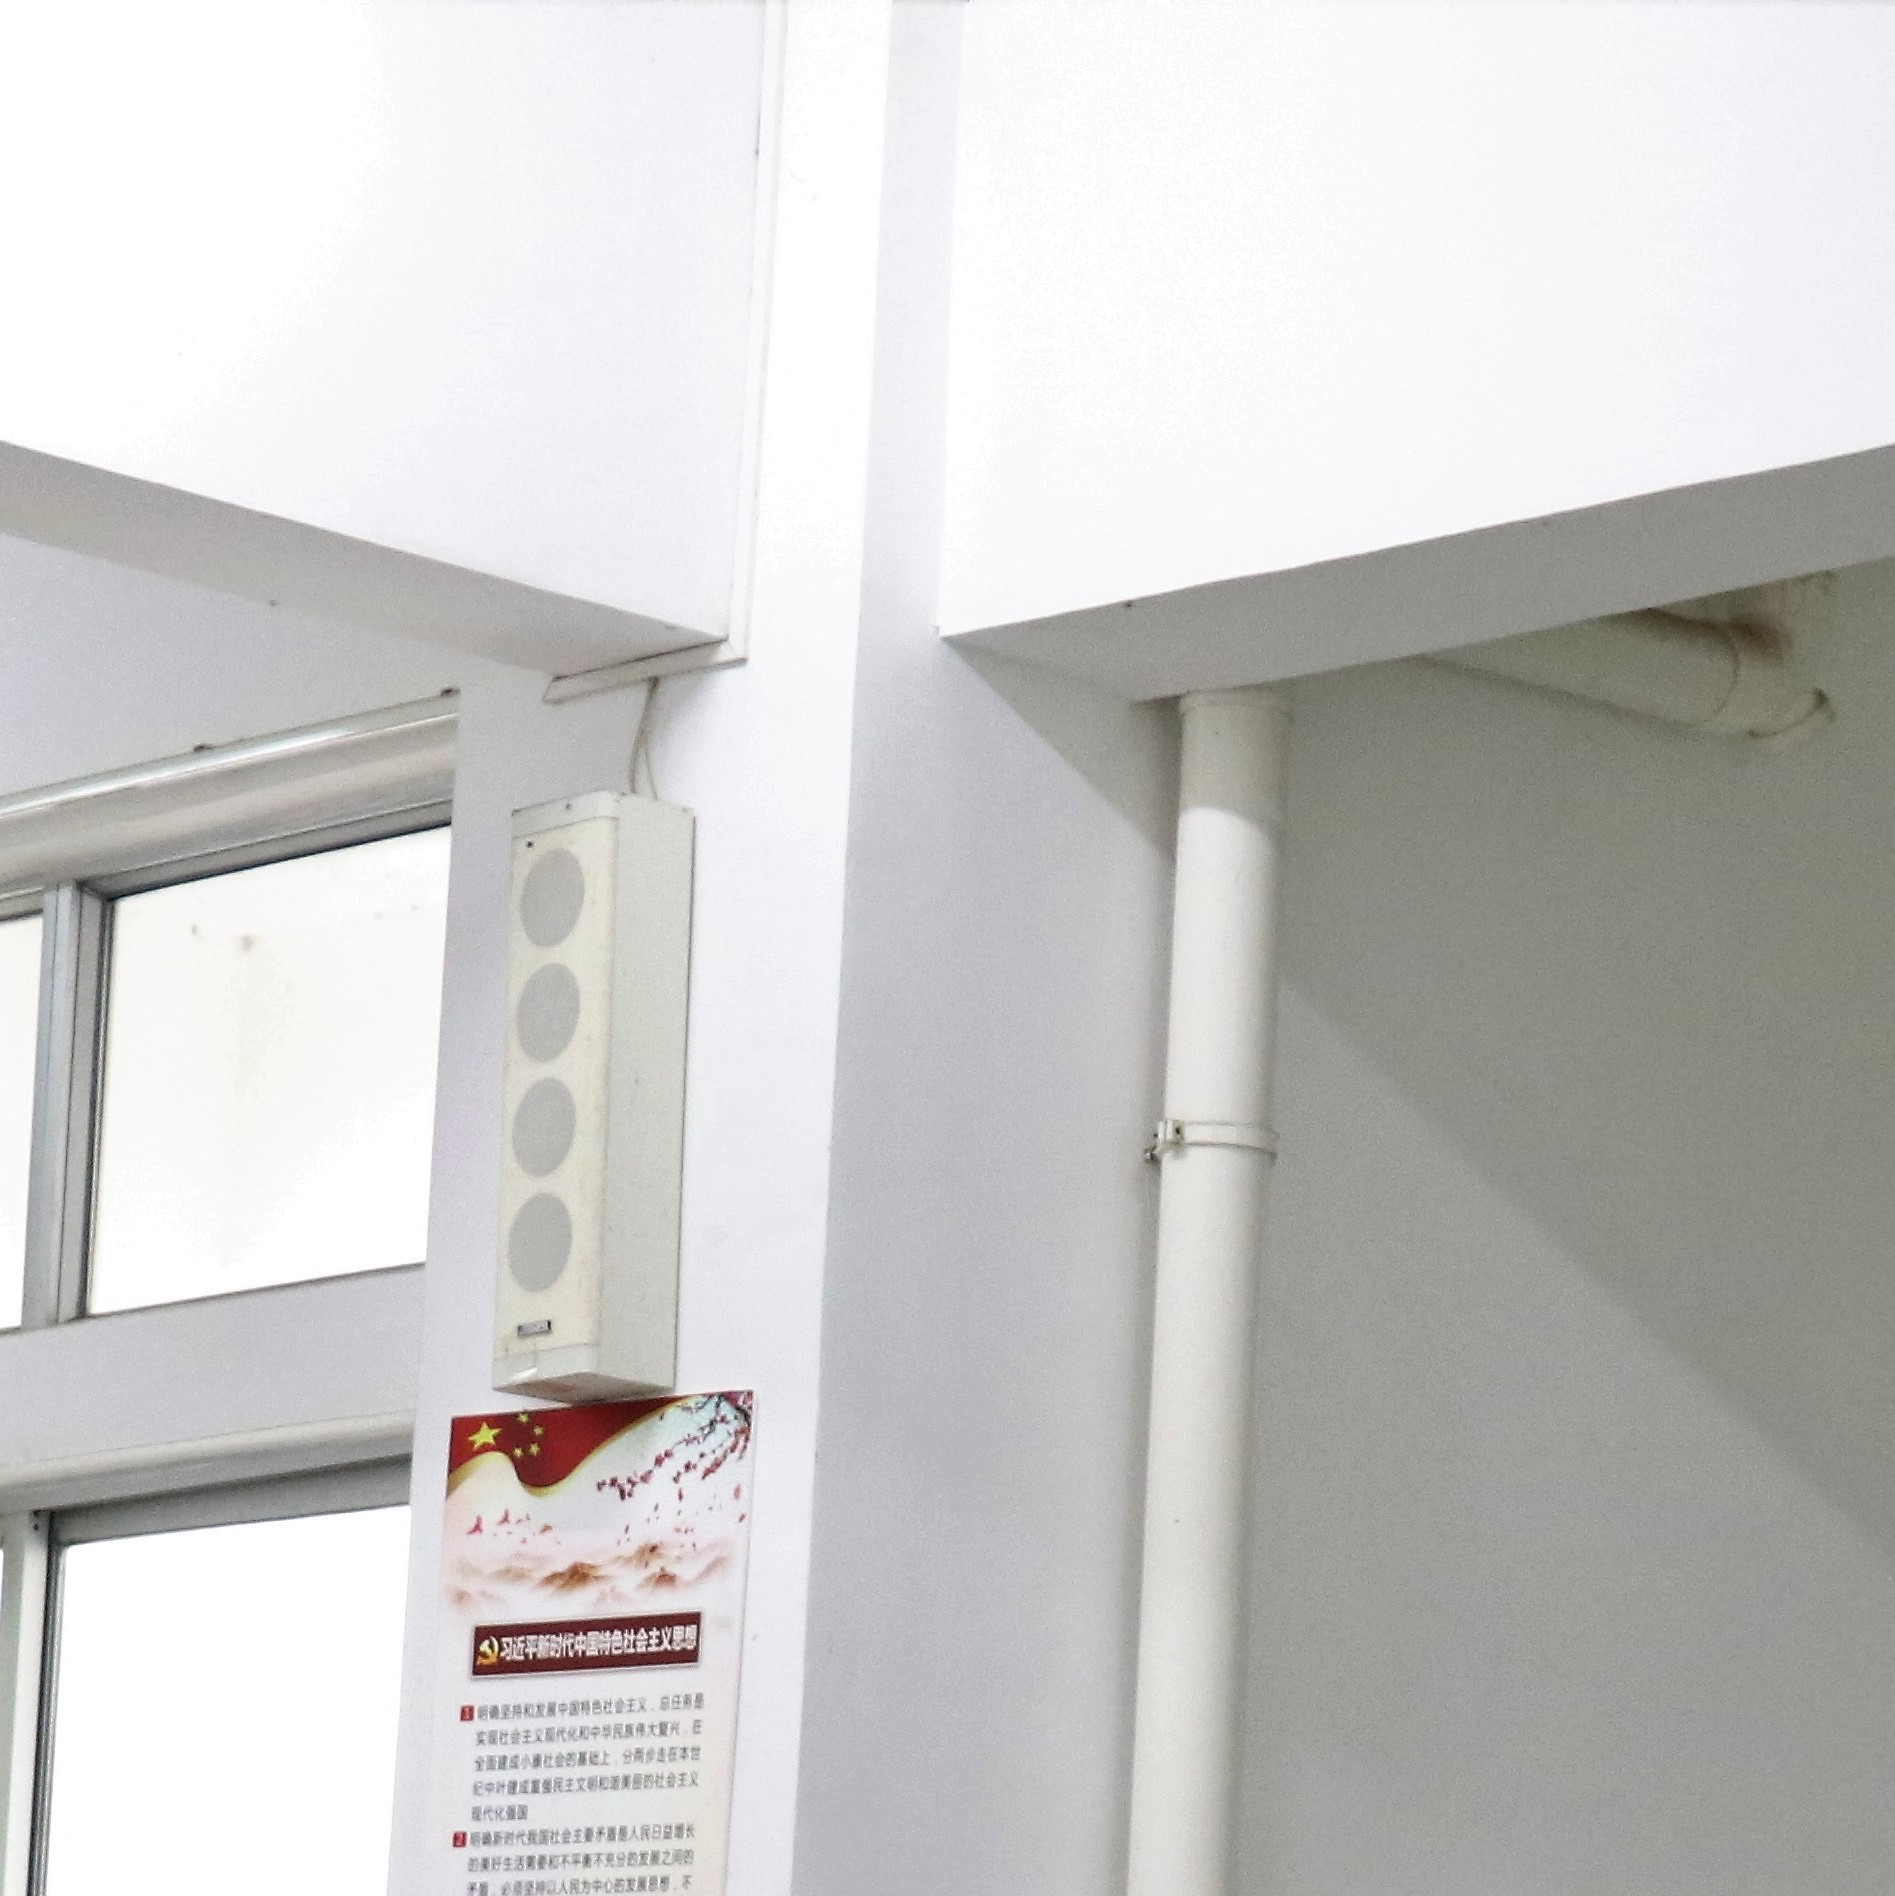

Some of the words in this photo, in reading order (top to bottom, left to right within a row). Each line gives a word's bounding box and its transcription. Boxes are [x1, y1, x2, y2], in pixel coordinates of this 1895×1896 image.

[500, 1624, 698, 1661] 习近平新时代中国特色社会主义思想
